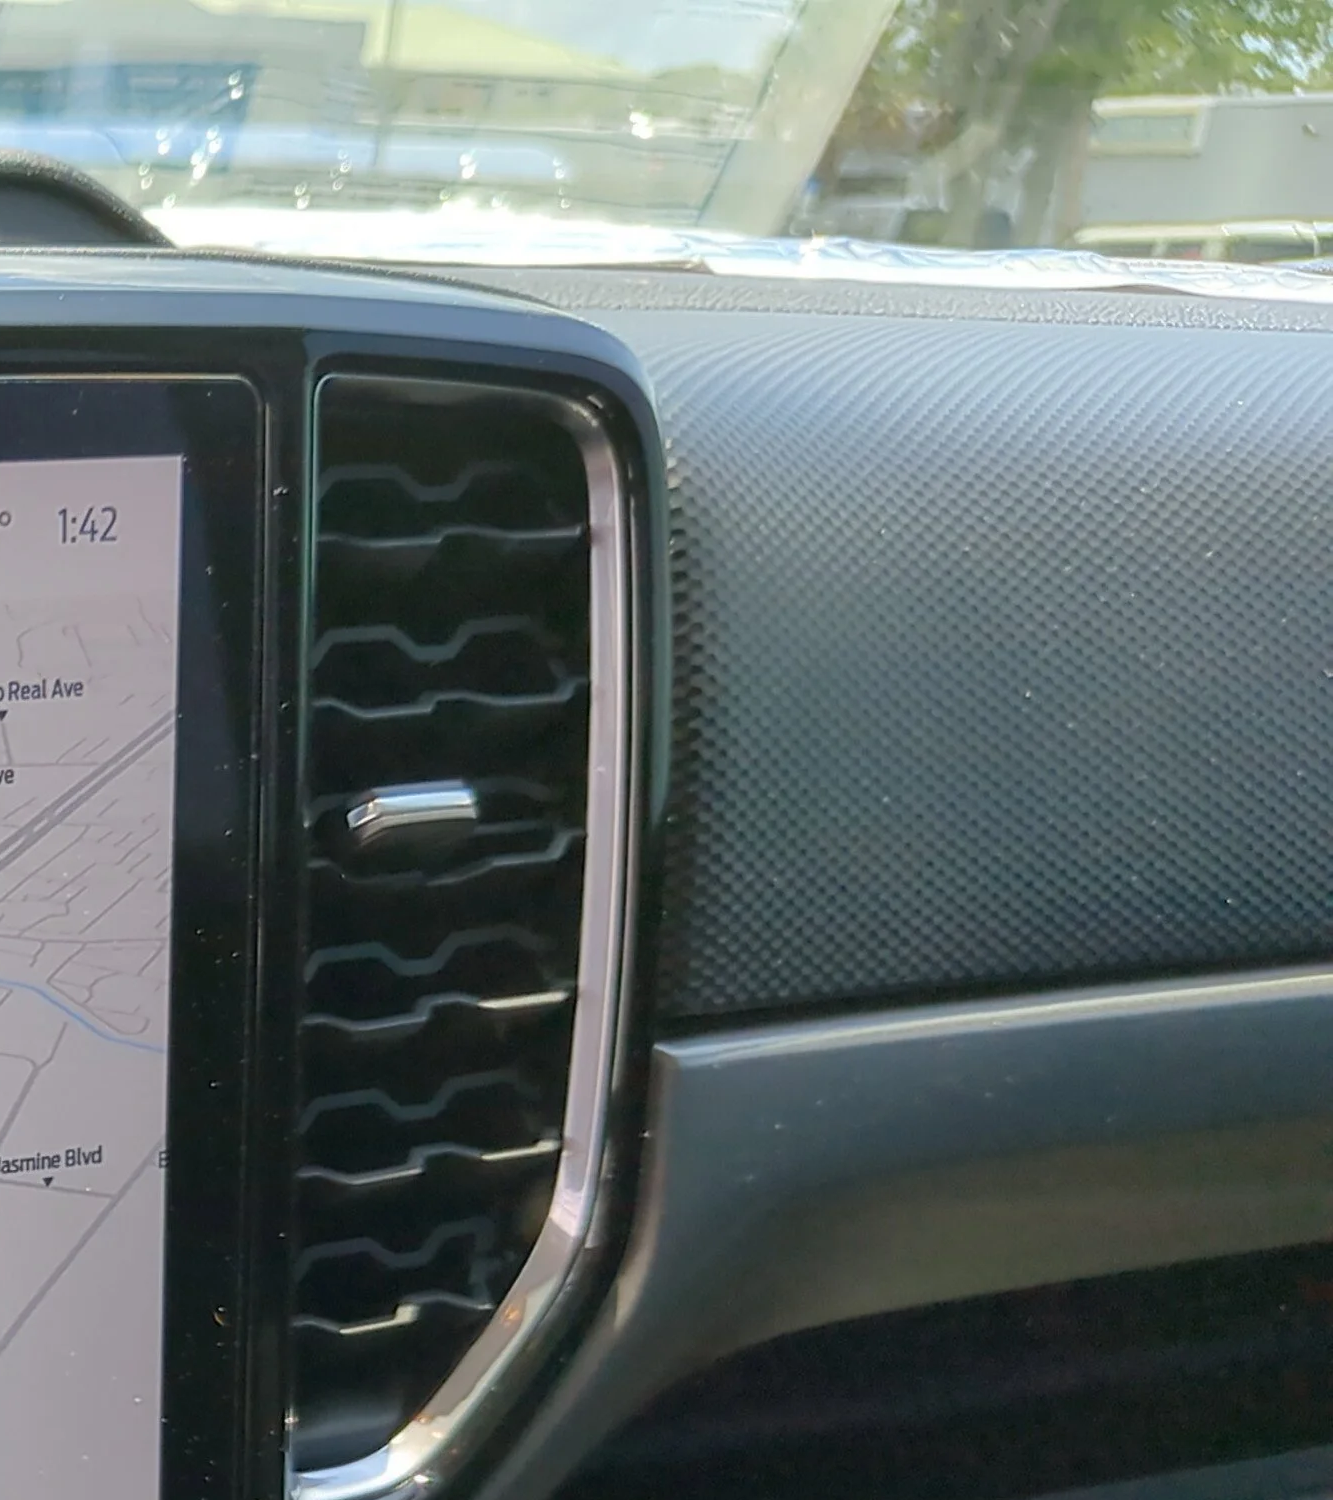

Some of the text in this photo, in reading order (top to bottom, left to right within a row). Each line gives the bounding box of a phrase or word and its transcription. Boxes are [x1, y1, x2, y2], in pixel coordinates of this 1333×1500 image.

[58, 507, 119, 545] 1:42
[8, 680, 46, 701] Real
[48, 678, 83, 698] Ave
[65, 1145, 102, 1168] Blvd
